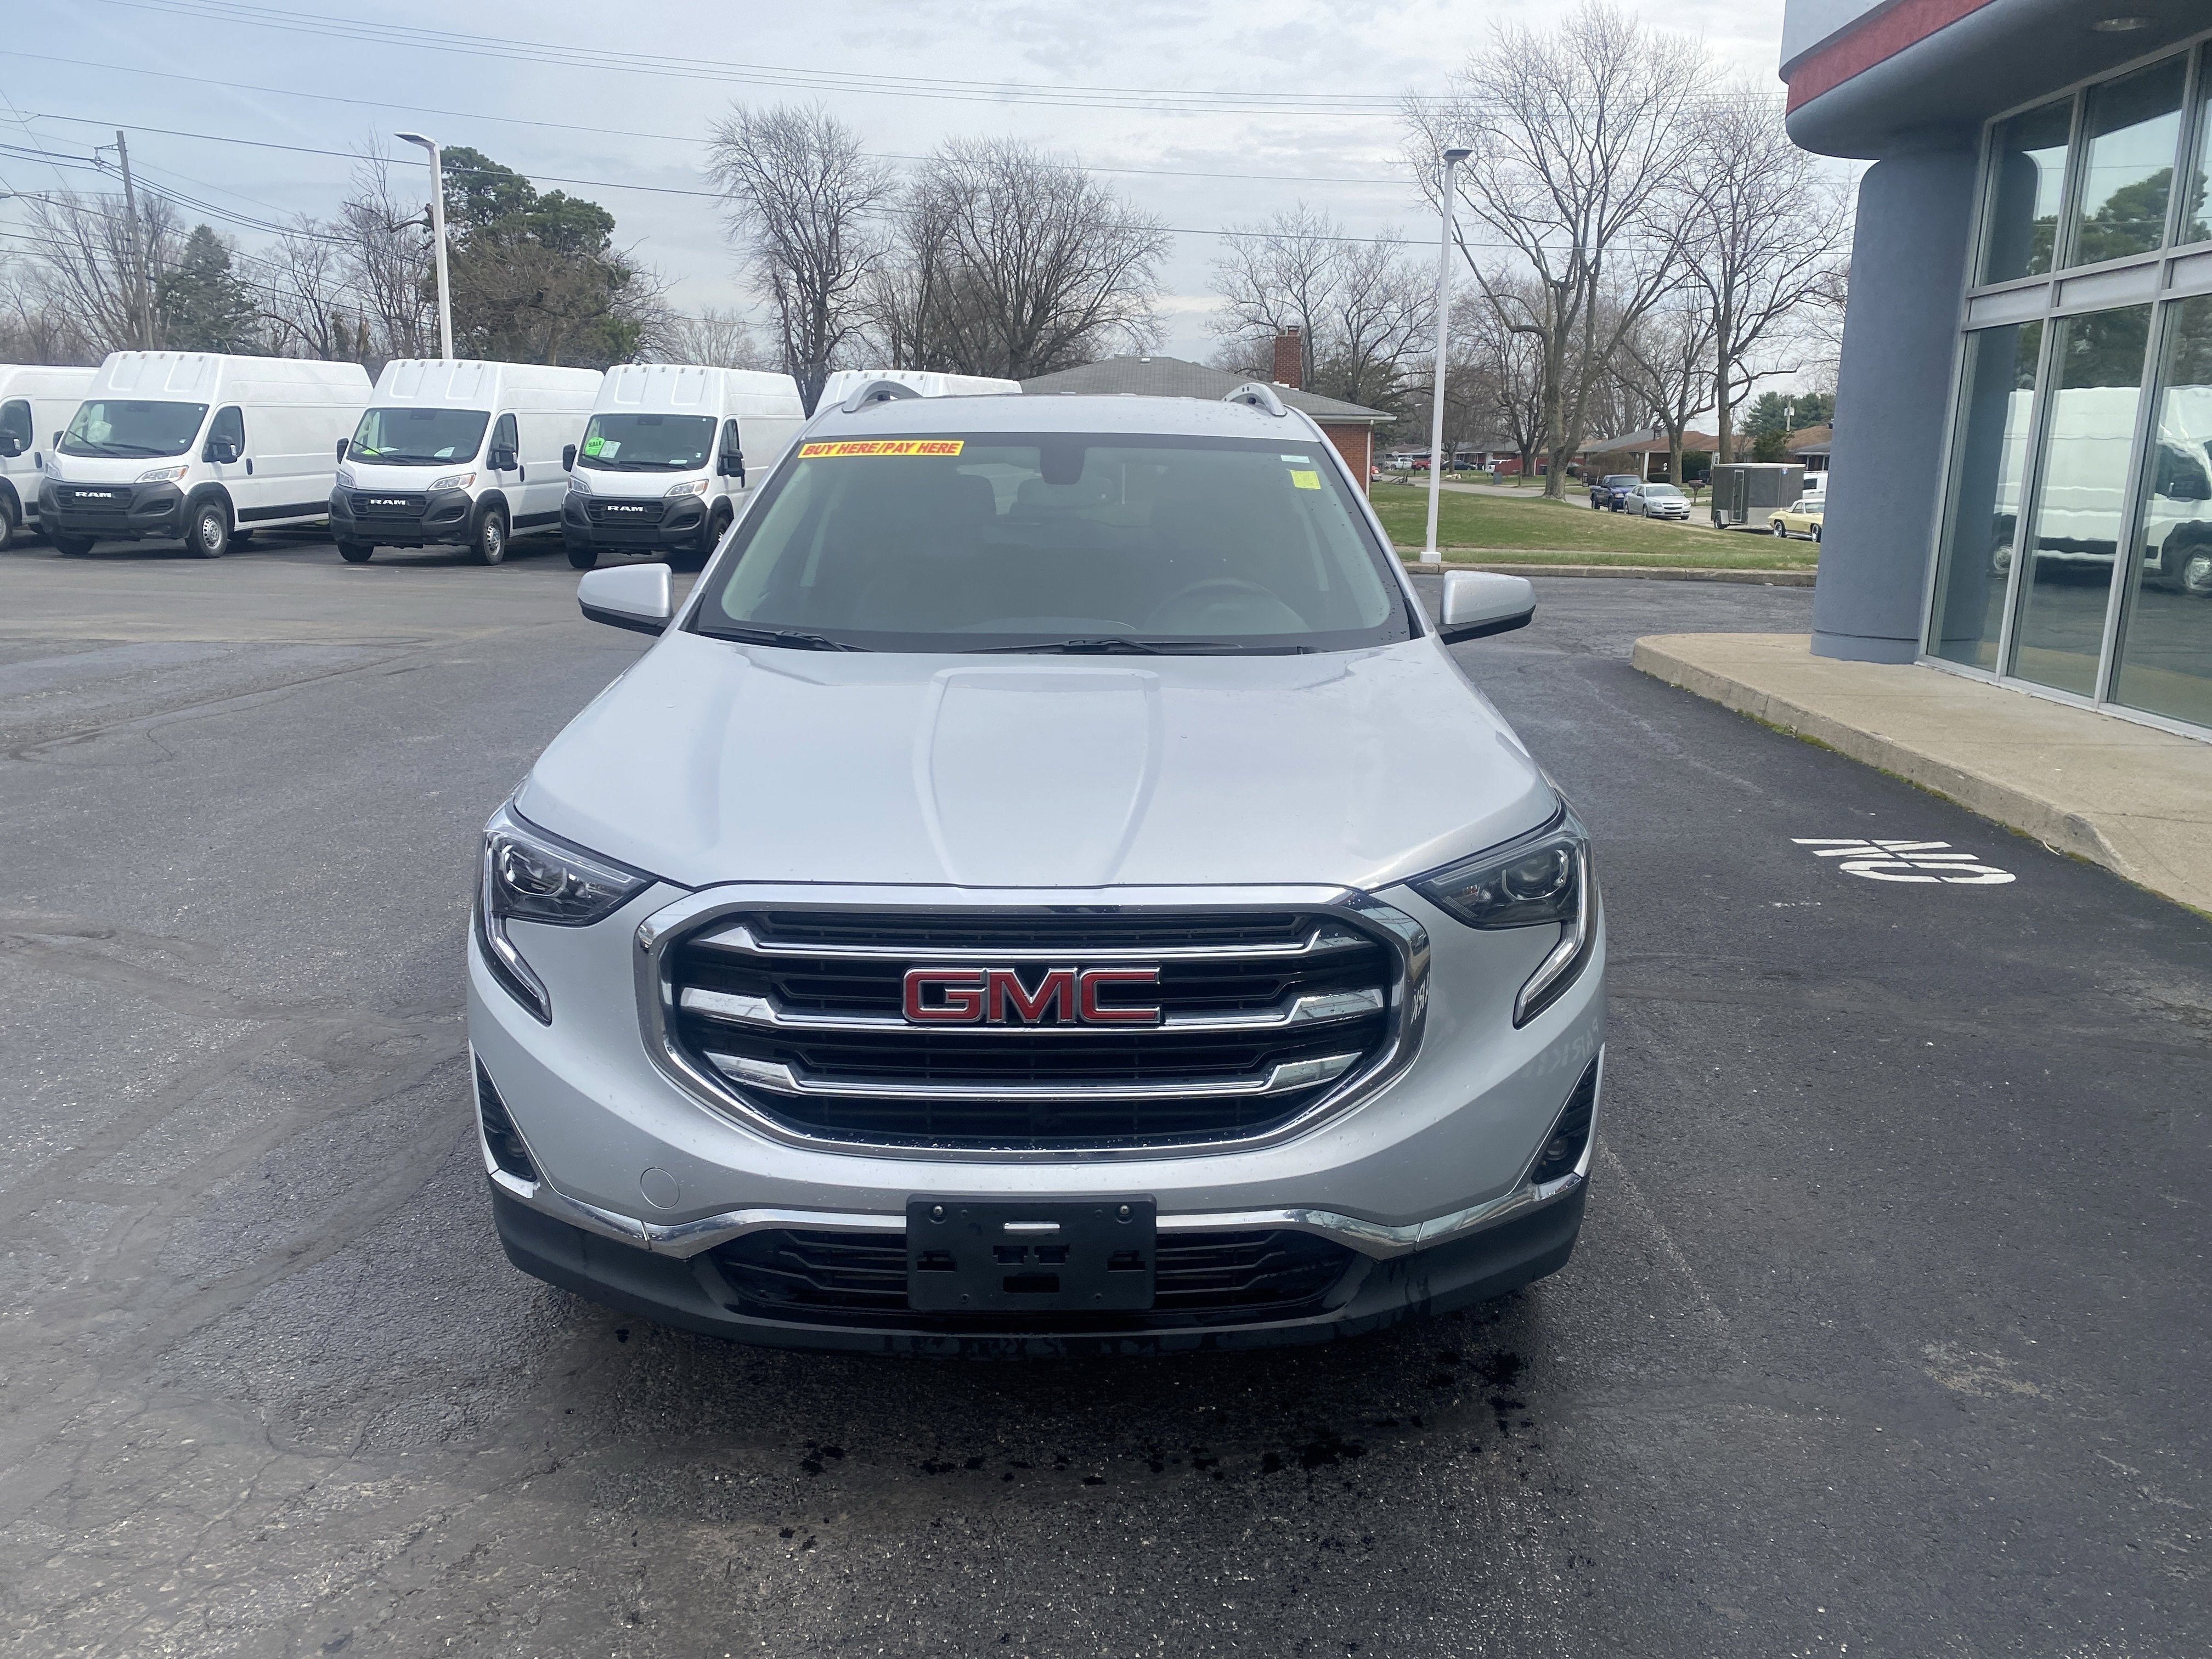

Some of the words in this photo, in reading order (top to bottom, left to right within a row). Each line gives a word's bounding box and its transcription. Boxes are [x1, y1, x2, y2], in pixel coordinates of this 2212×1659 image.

[802, 445, 837, 455] BUY
[838, 443, 914, 454] HERE/PAY
[916, 443, 959, 453] HERE
[902, 967, 1161, 1024] GMC
